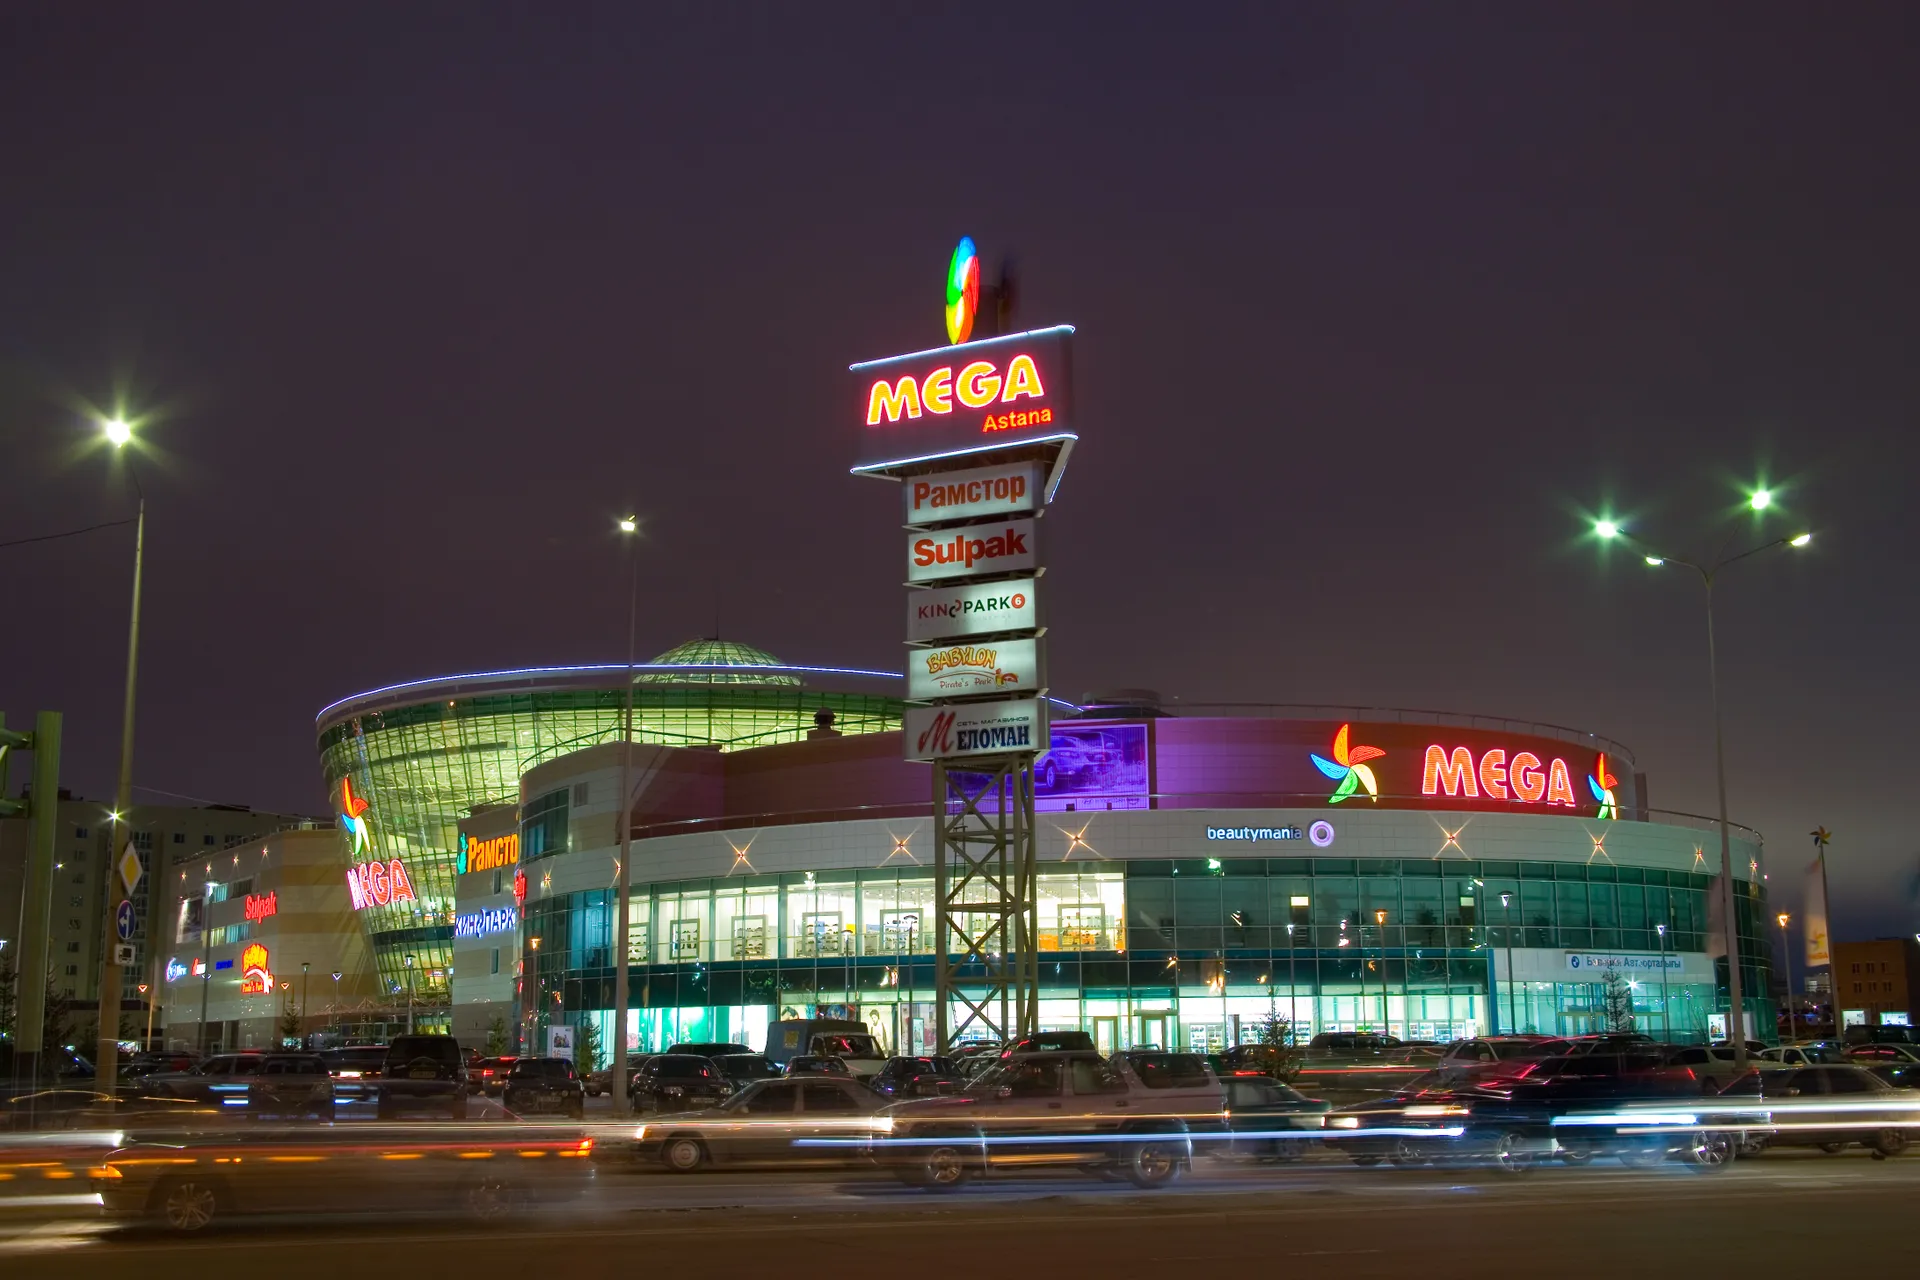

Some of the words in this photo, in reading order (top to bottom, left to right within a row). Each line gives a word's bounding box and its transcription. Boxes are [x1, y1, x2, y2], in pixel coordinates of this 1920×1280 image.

[866, 354, 1045, 426] MEGA
[982, 408, 1052, 433] Astana
[913, 475, 1026, 510] Рамстор
[913, 528, 1028, 569] Sulpak
[926, 646, 997, 674] BABYLON
[940, 677, 969, 689] Pirate's
[974, 677, 992, 686] Park
[980, 716, 1030, 725] МАГАЗИНОВ
[1422, 744, 1576, 807] MEGA
[1206, 825, 1303, 843] beautymania
[467, 833, 519, 873] Рамсто
[346, 859, 418, 911] MEGA
[244, 891, 277, 924] Sulpak
